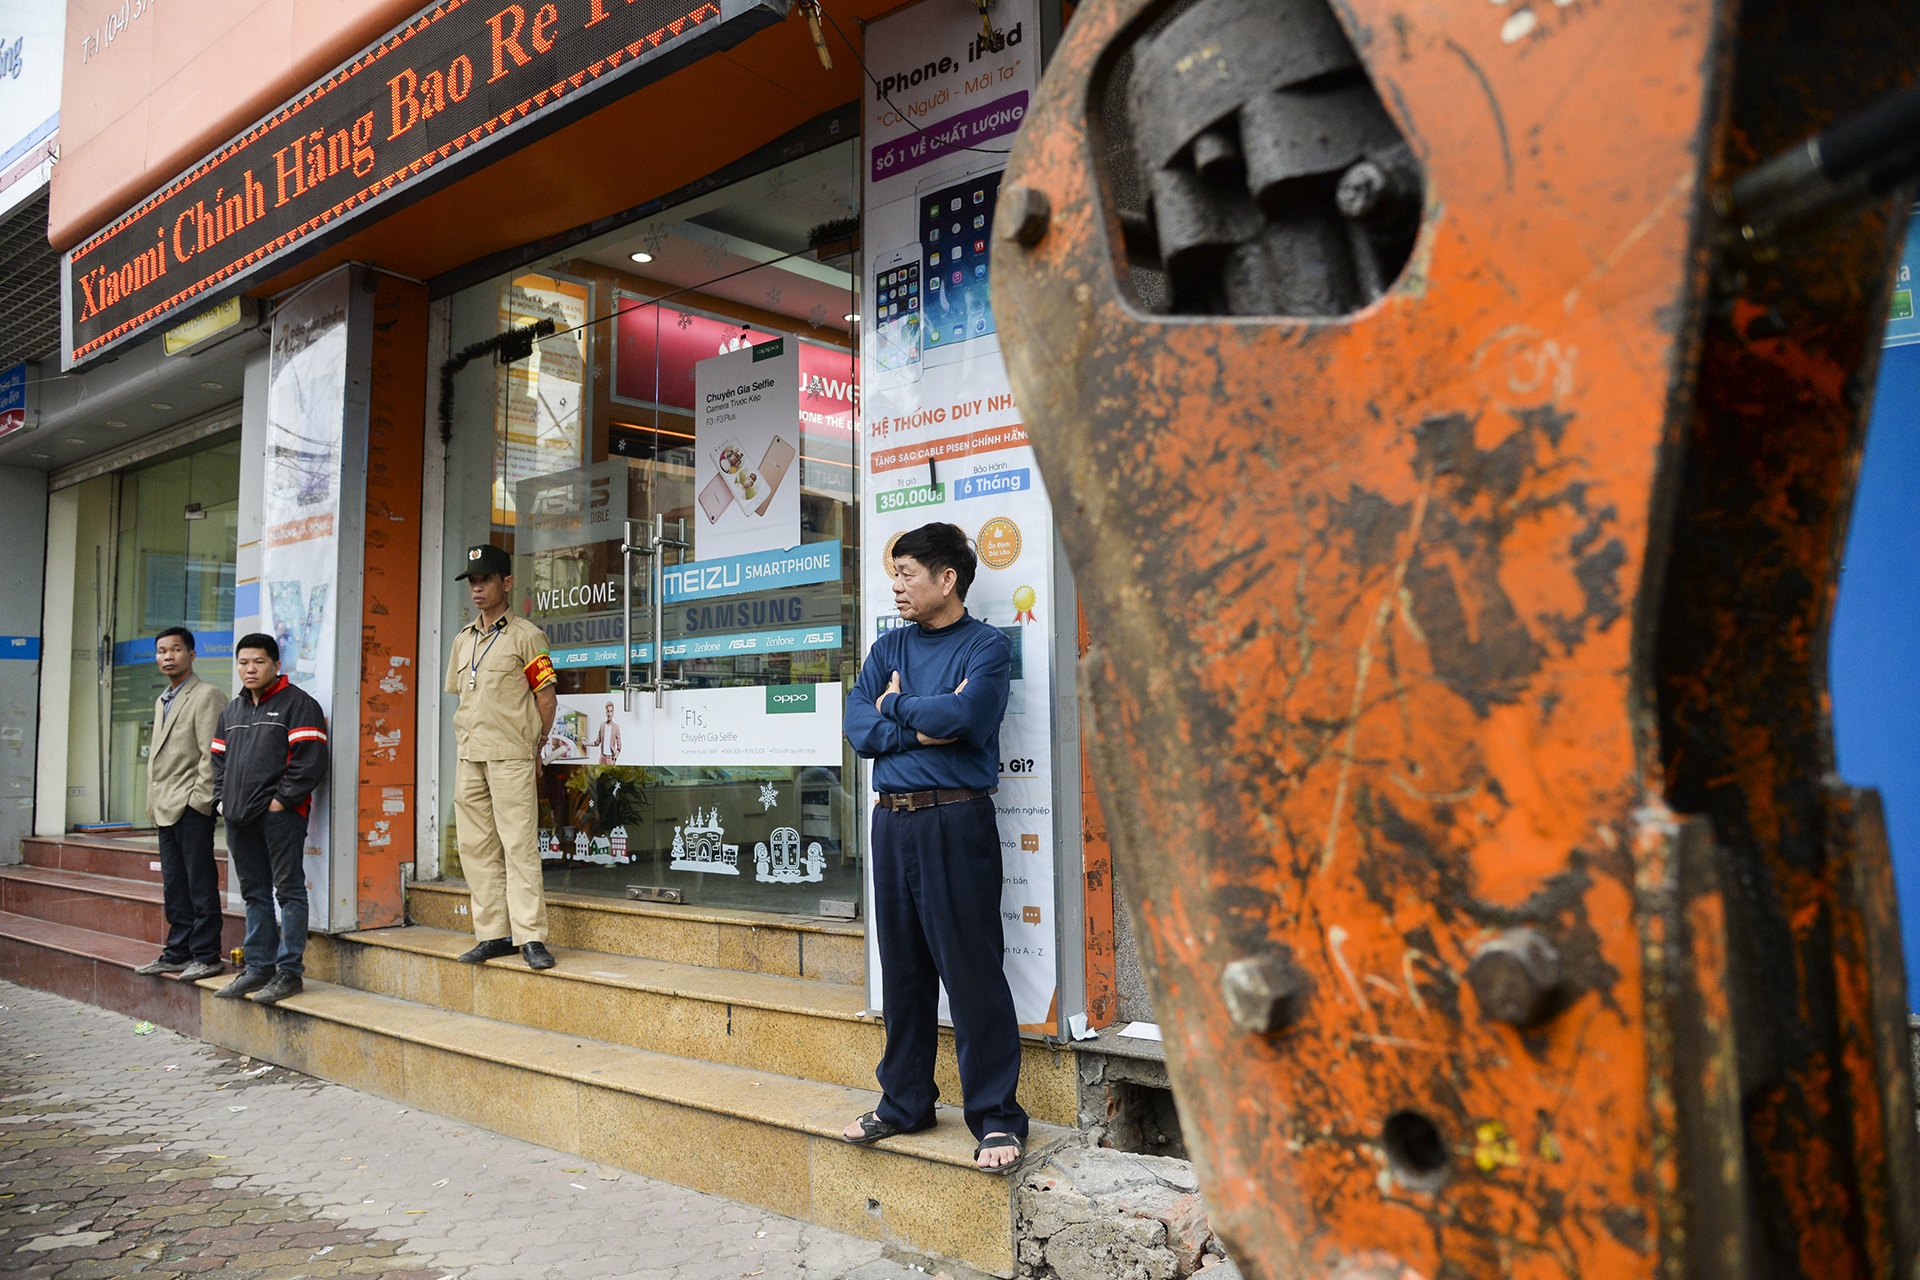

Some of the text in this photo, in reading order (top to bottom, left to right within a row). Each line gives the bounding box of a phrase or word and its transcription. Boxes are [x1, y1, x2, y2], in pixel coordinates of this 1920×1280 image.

[876, 56, 959, 101] iPhone,
[907, 90, 950, 118] Người
[965, 73, 993, 96] Mới
[876, 105, 1024, 171] SỐ 1 VỀ CHẤT LƯỢNG
[79, 227, 167, 323] Xiaomi
[173, 170, 267, 264] Chính
[272, 110, 376, 208] Hãng
[387, 54, 473, 141] Bao
[706, 378, 775, 403] Chuyên Gia Selfie
[705, 403, 730, 414] Camera
[871, 416, 889, 439] HỆ
[893, 406, 947, 433] THỐNG
[951, 399, 983, 421] DUY
[826, 415, 845, 429] THẾ
[898, 452, 917, 464] SẠC
[917, 445, 944, 460] CABLE
[946, 441, 970, 454] PISEN
[971, 432, 1001, 449] CHÍNH
[988, 461, 1008, 472] Hành
[964, 474, 1021, 494] 6 Tháng
[663, 553, 831, 596] MEIZU SMARTPHONE
[537, 581, 617, 611] WELCOME
[686, 596, 802, 632] SAMSUNG
[540, 616, 624, 645] AMSUNG
[694, 641, 721, 653] Zenfone
[728, 638, 758, 649] ASUS
[766, 634, 795, 645] Zenfone
[803, 632, 835, 643] ASUS
[566, 653, 588, 663] ASUS
[595, 650, 618, 661] Zenfone
[681, 731, 738, 744] Chuyên Gia Selfie
[1009, 758, 1035, 773] Gì?
[1022, 805, 1050, 816] nghiệp
[1022, 947, 1029, 955] A
[1037, 947, 1043, 956] Z
